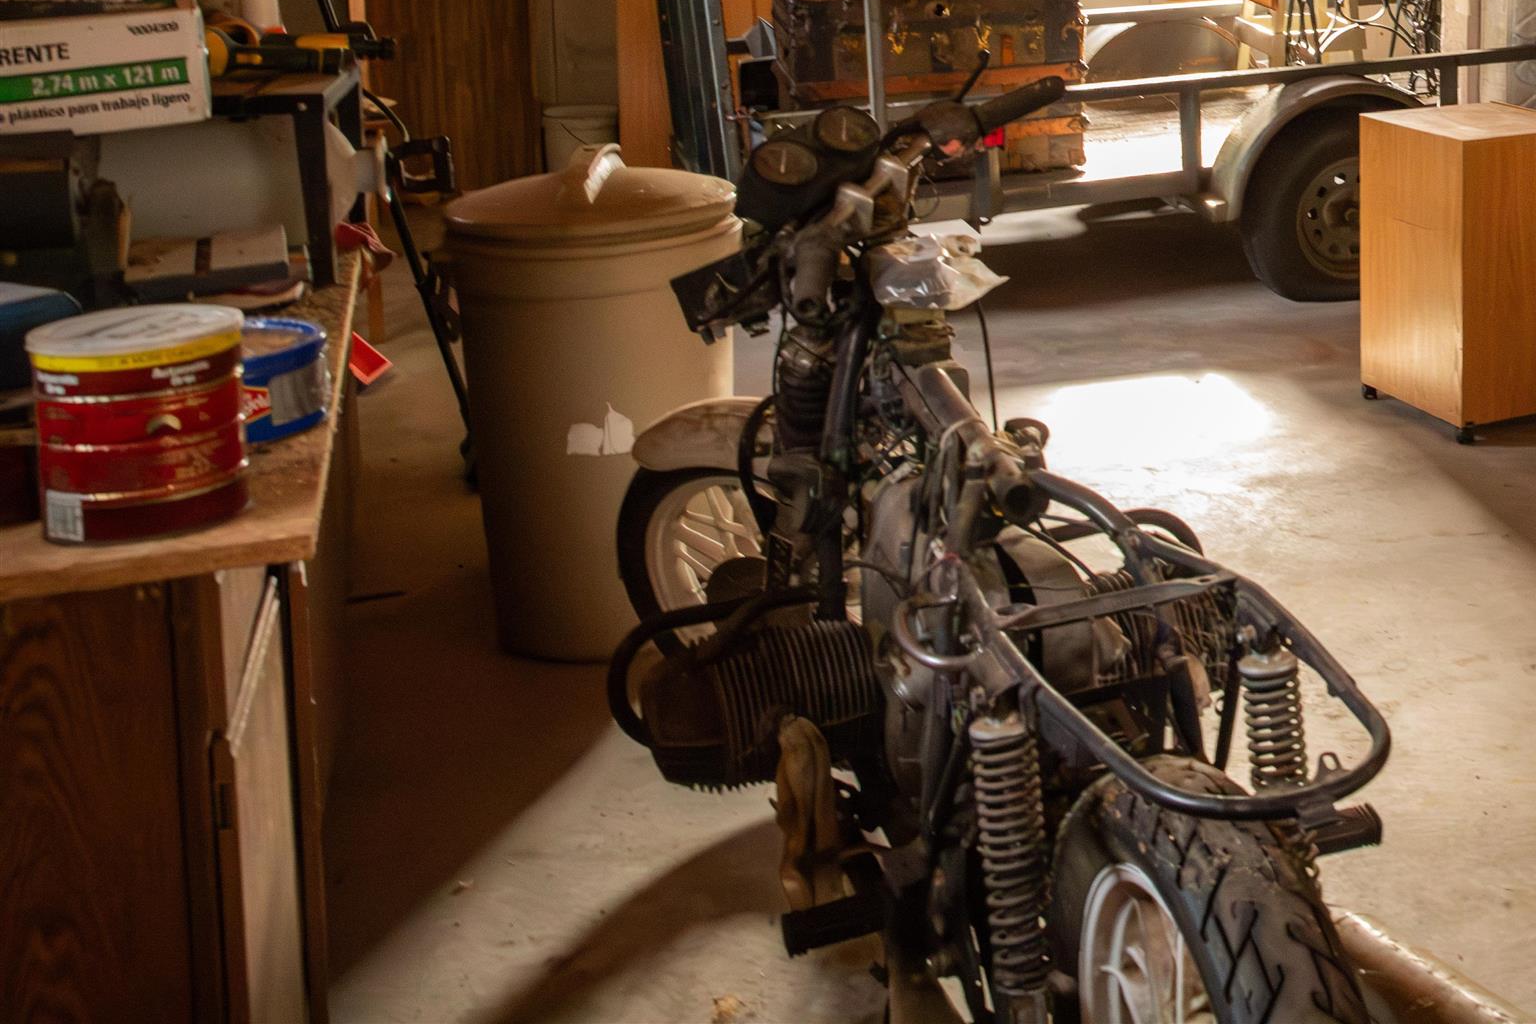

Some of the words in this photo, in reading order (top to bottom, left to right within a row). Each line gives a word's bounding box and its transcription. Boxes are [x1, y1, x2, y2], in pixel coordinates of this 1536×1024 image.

[79, 74, 99, 91] m
[104, 73, 117, 88] x
[122, 64, 154, 85] 121
[161, 65, 180, 81] m
[9, 107, 65, 125] plástico
[68, 102, 99, 118] para
[102, 95, 149, 111] trabajo
[152, 91, 190, 107] ligero
